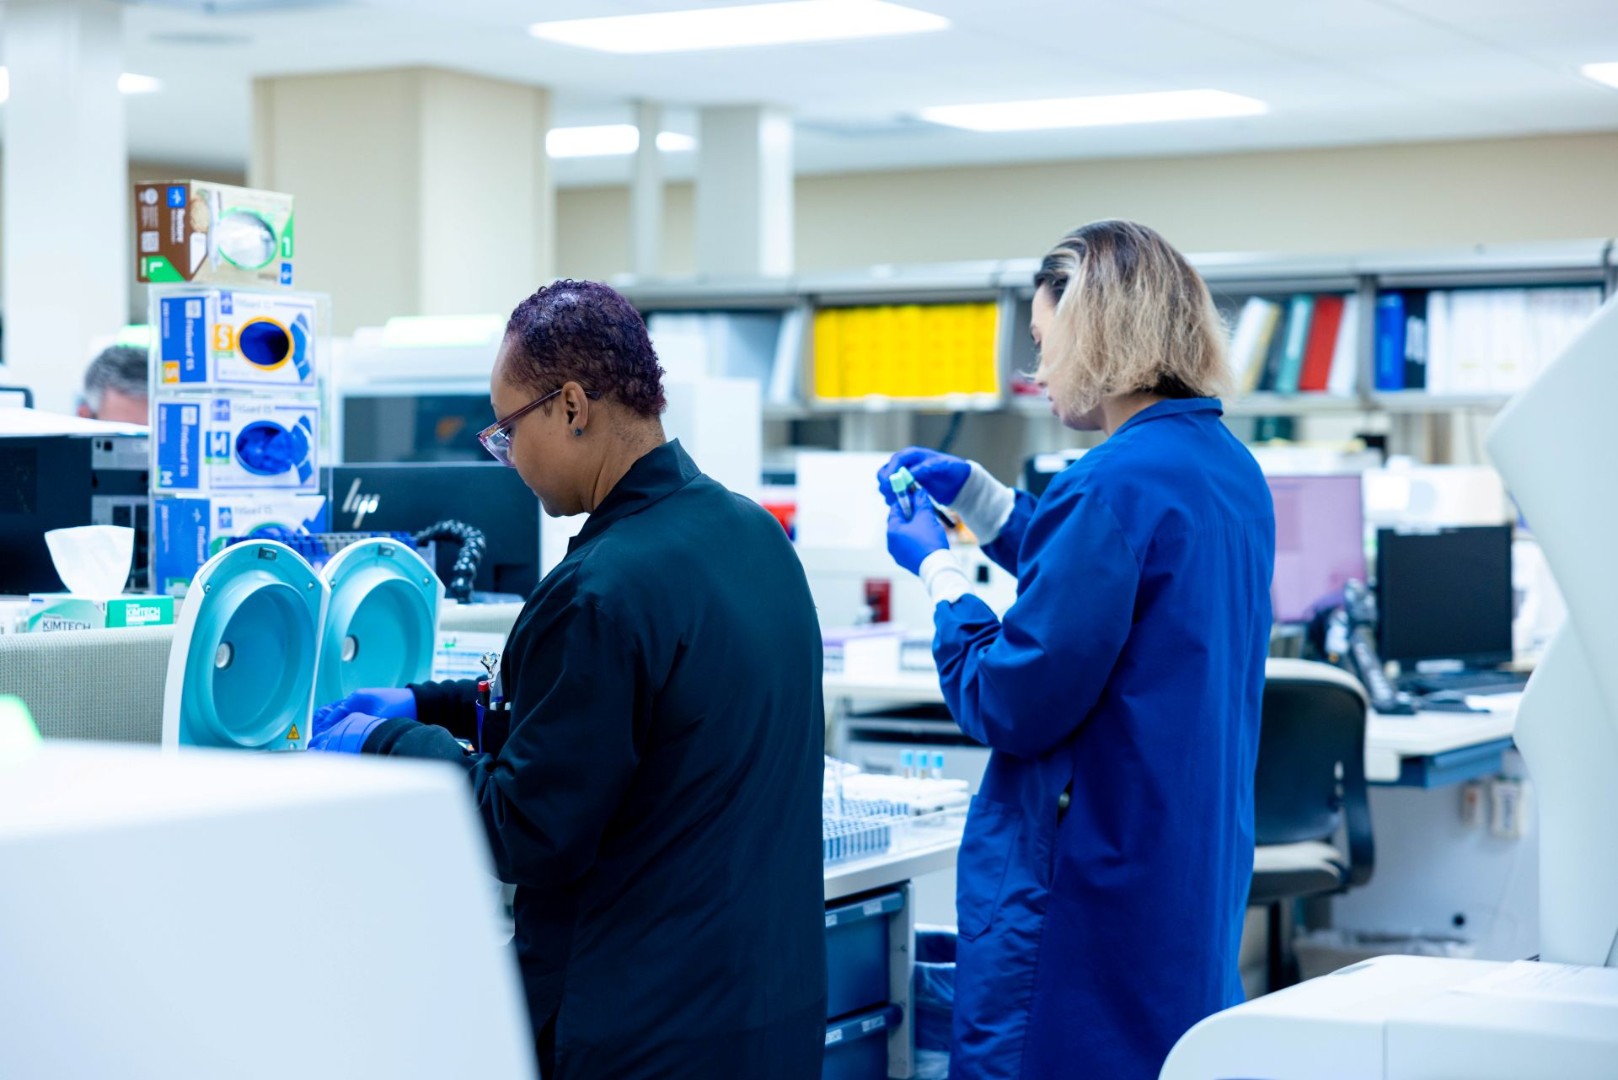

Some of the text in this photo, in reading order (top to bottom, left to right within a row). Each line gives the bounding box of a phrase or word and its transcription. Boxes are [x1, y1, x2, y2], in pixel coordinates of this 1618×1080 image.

[149, 260, 163, 273] L
[219, 327, 230, 346] S
[161, 470, 173, 486] M
[342, 477, 380, 529] hp
[126, 607, 160, 617] KIMTECH
